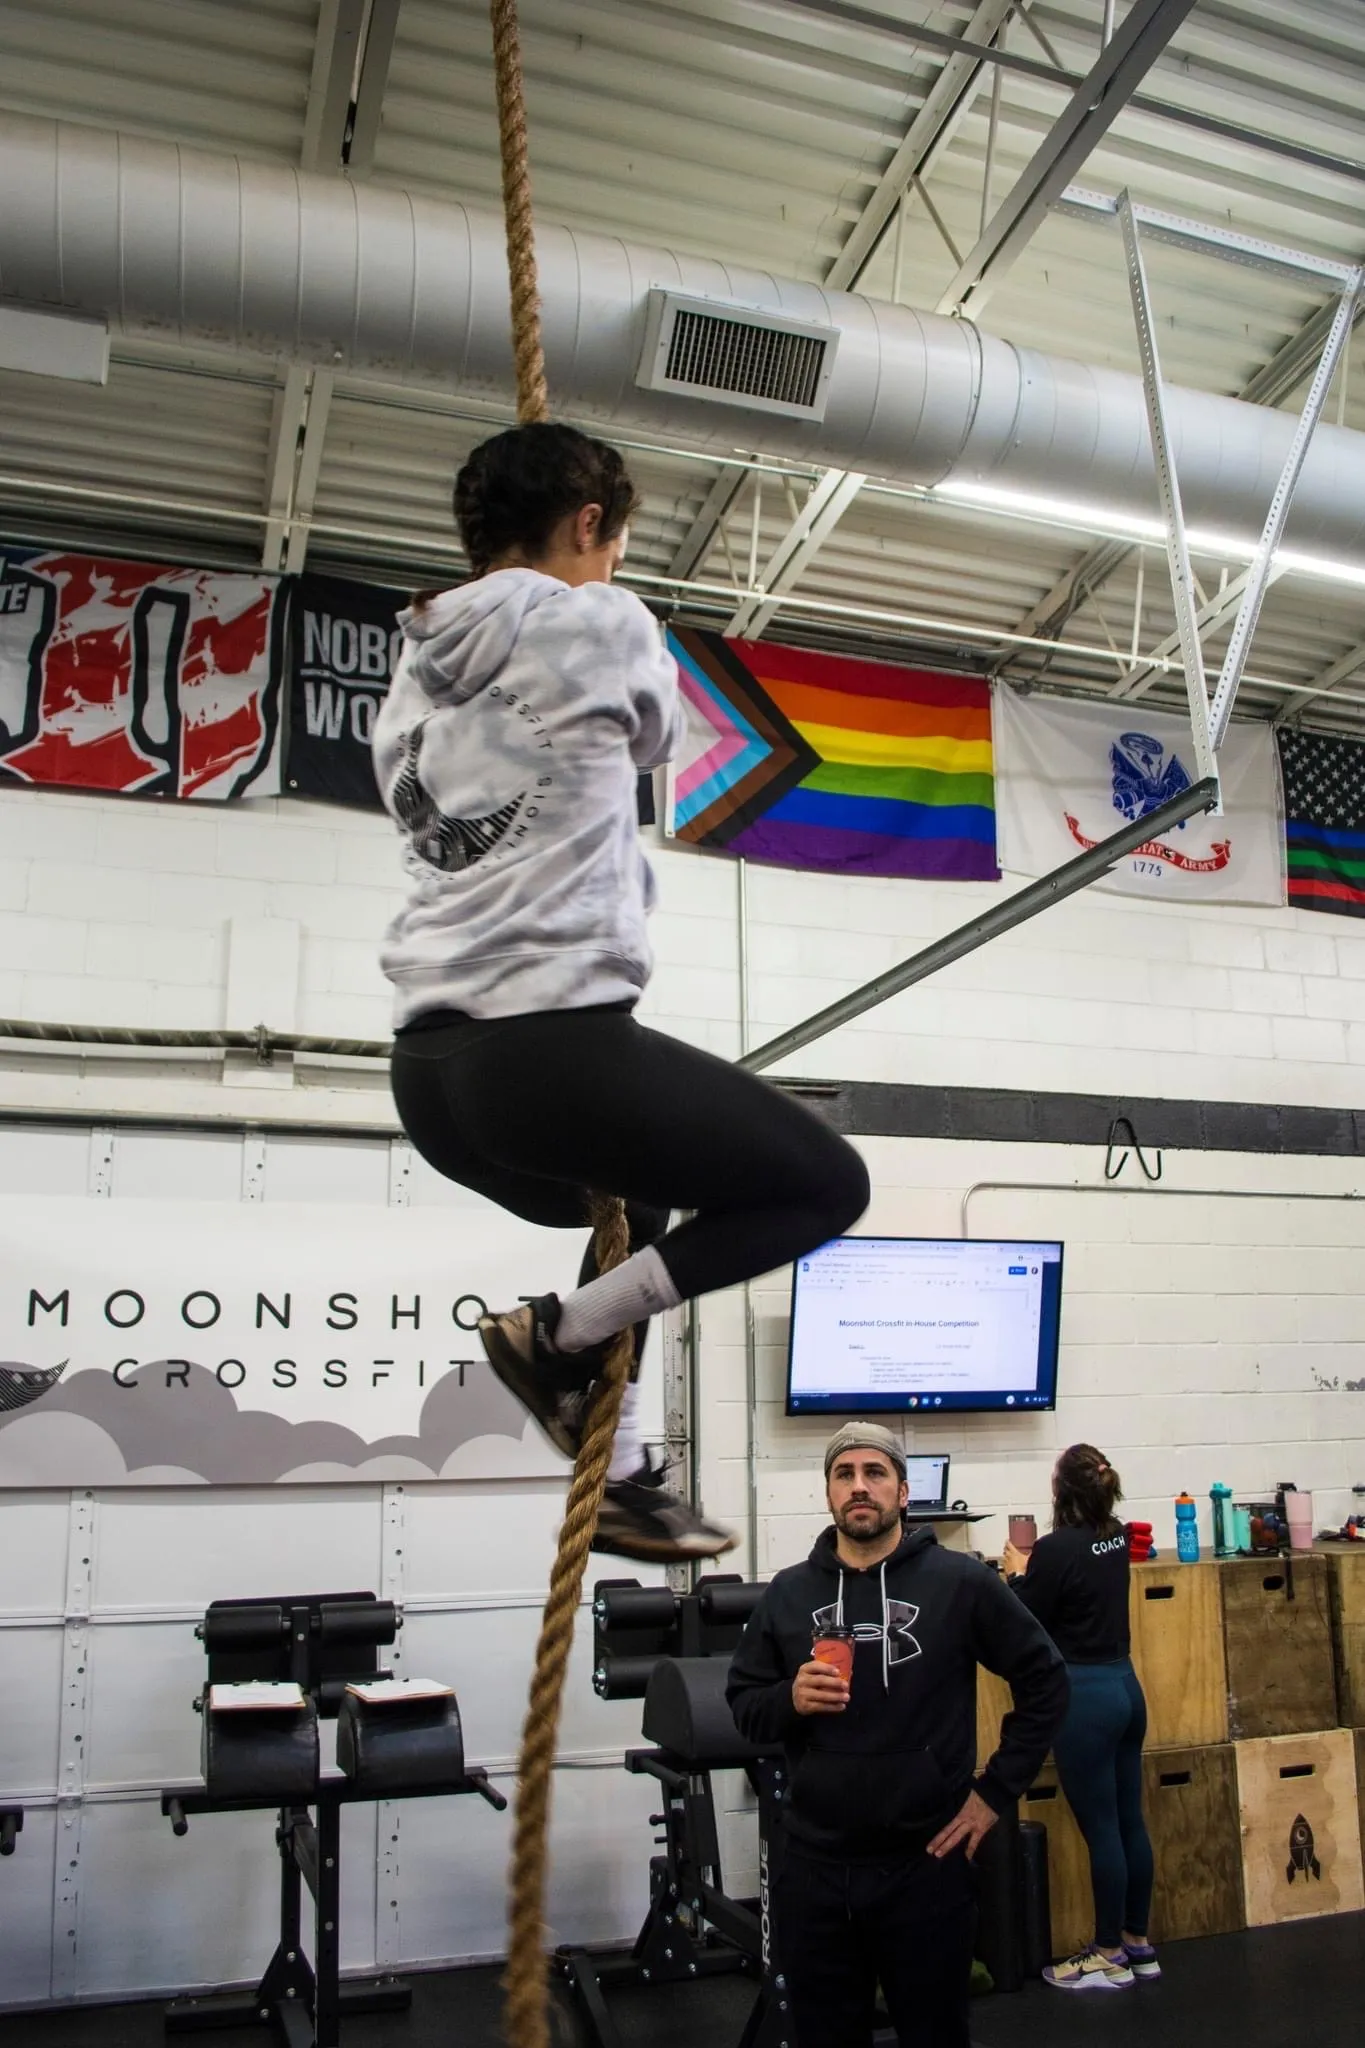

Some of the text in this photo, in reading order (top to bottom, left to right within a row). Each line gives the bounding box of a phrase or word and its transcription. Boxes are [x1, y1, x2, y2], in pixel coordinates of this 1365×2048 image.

[304, 681, 388, 746] WO
[488, 685, 553, 748] OSSFIT
[1133, 860, 1162, 877] 1775
[1180, 858, 1217, 871] ARMY
[28, 1288, 541, 1331] MOONSHO
[839, 1319, 875, 1327] Moonshot
[876, 1319, 904, 1327] Crossfit
[938, 1319, 980, 1329] Competition
[112, 1358, 475, 1388] CROSSFIT
[1091, 1535, 1126, 1555] COACH
[760, 1839, 771, 1966] ROGUE
